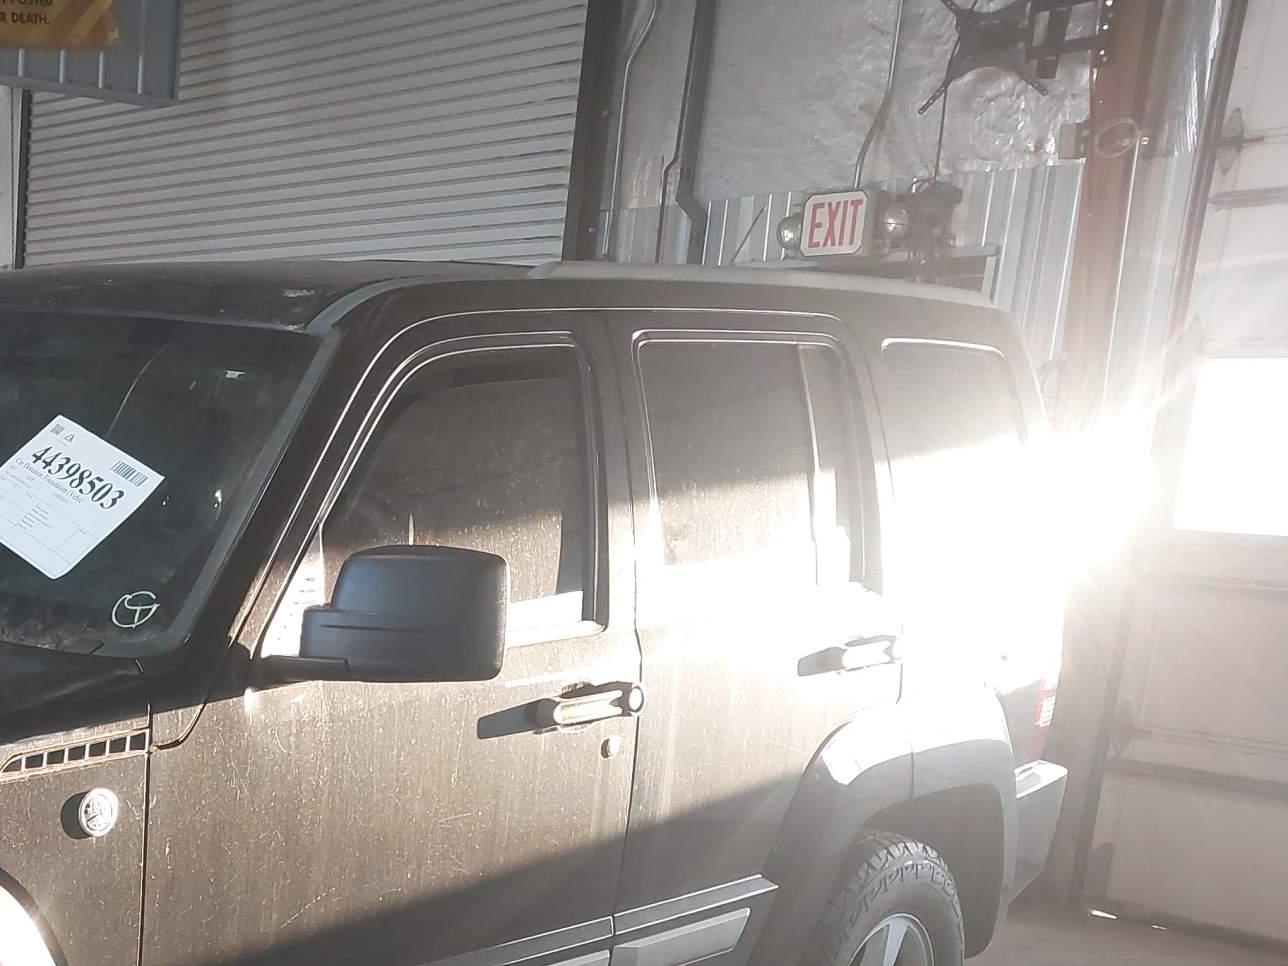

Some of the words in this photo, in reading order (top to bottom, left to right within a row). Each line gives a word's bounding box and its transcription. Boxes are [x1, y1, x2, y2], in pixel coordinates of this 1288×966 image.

[11, 12, 51, 25] DEATH.
[808, 199, 863, 248] EXIT
[32, 446, 124, 509] 44398503
